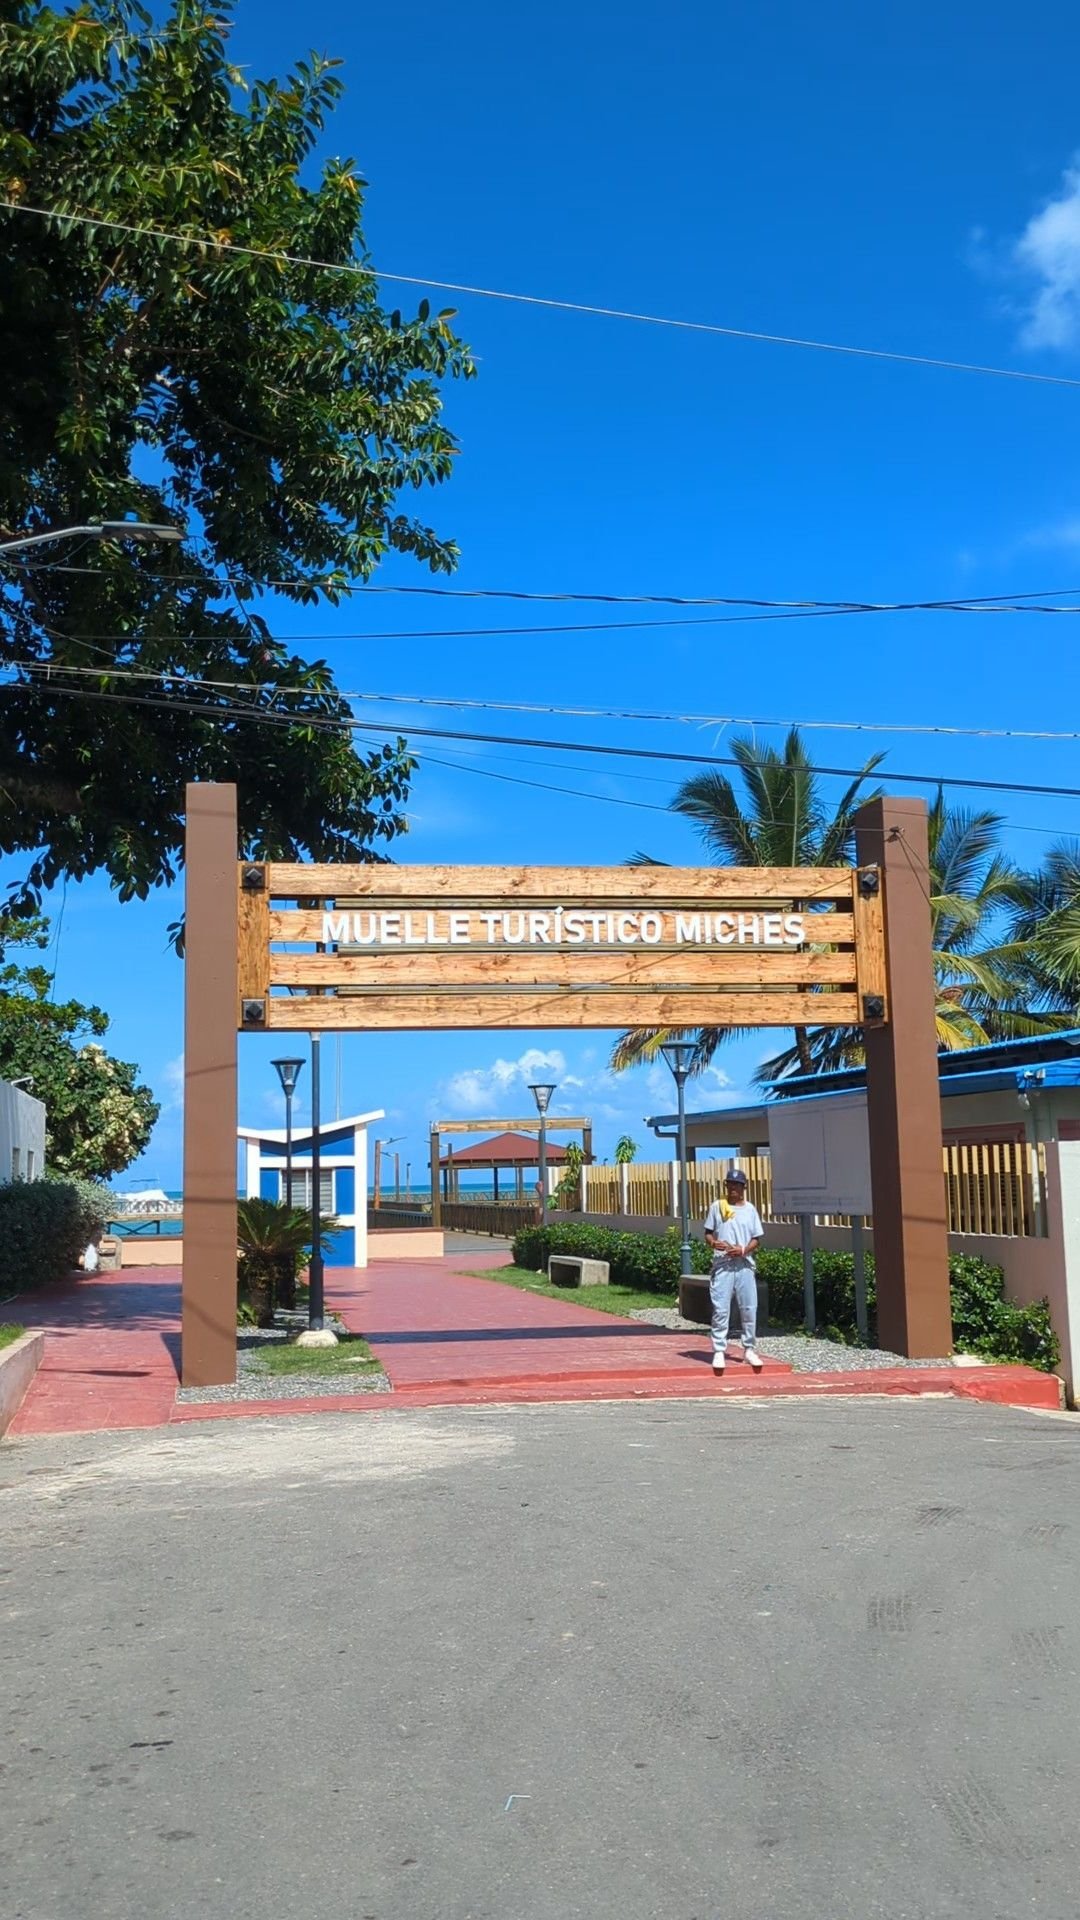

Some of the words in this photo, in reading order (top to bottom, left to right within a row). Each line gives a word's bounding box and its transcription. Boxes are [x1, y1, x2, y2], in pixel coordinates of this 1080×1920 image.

[321, 912, 470, 945] MUELLE
[481, 905, 662, 945] TURÍSTICO
[675, 913, 806, 946] MICHES
